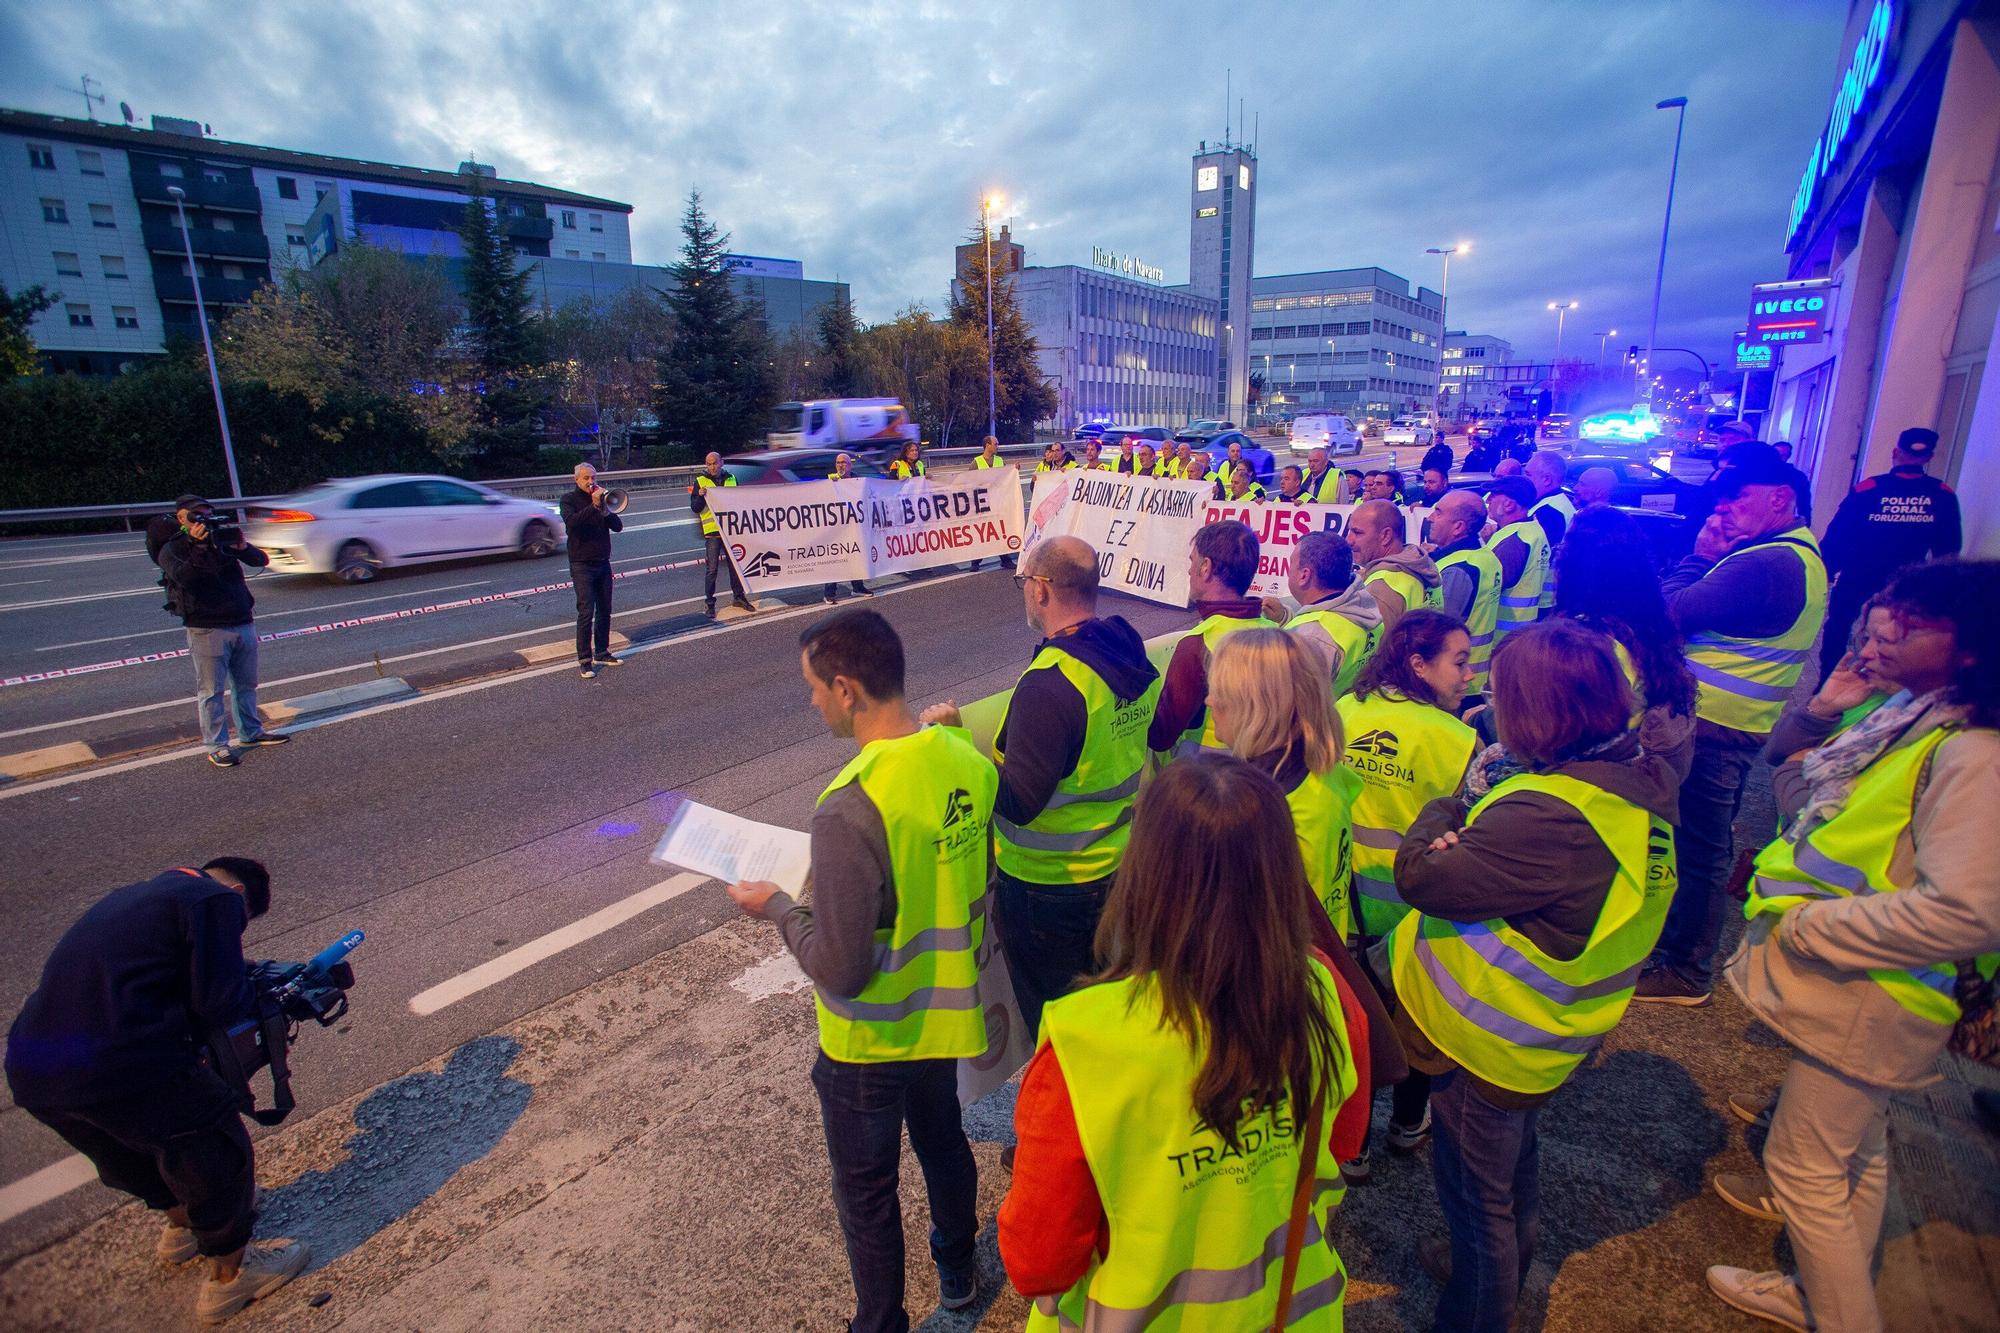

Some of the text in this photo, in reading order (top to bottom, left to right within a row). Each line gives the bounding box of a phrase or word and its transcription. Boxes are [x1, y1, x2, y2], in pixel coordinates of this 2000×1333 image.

[1093, 246, 1163, 280] Diario de Navarra
[1755, 297, 1824, 315] IVECO
[1762, 331, 1806, 341] PARTS
[1072, 478, 1134, 511] BALDINTZA
[1881, 496, 1931, 505] POLICÍA
[715, 488, 991, 536] TRANSPORTISTAS AL BORDE
[1869, 514, 1934, 523] FORUZAINGOA
[1883, 506, 1926, 514] FORAL
[886, 525, 973, 558] SOLUCIONES
[1106, 520, 1136, 546] EZ
[1258, 555, 1291, 576] BAN
[1167, 1118, 1293, 1177] TRADiS
[1183, 1166, 1245, 1193] ASOCIACIÓN
[1236, 1177, 1248, 1185] DE
